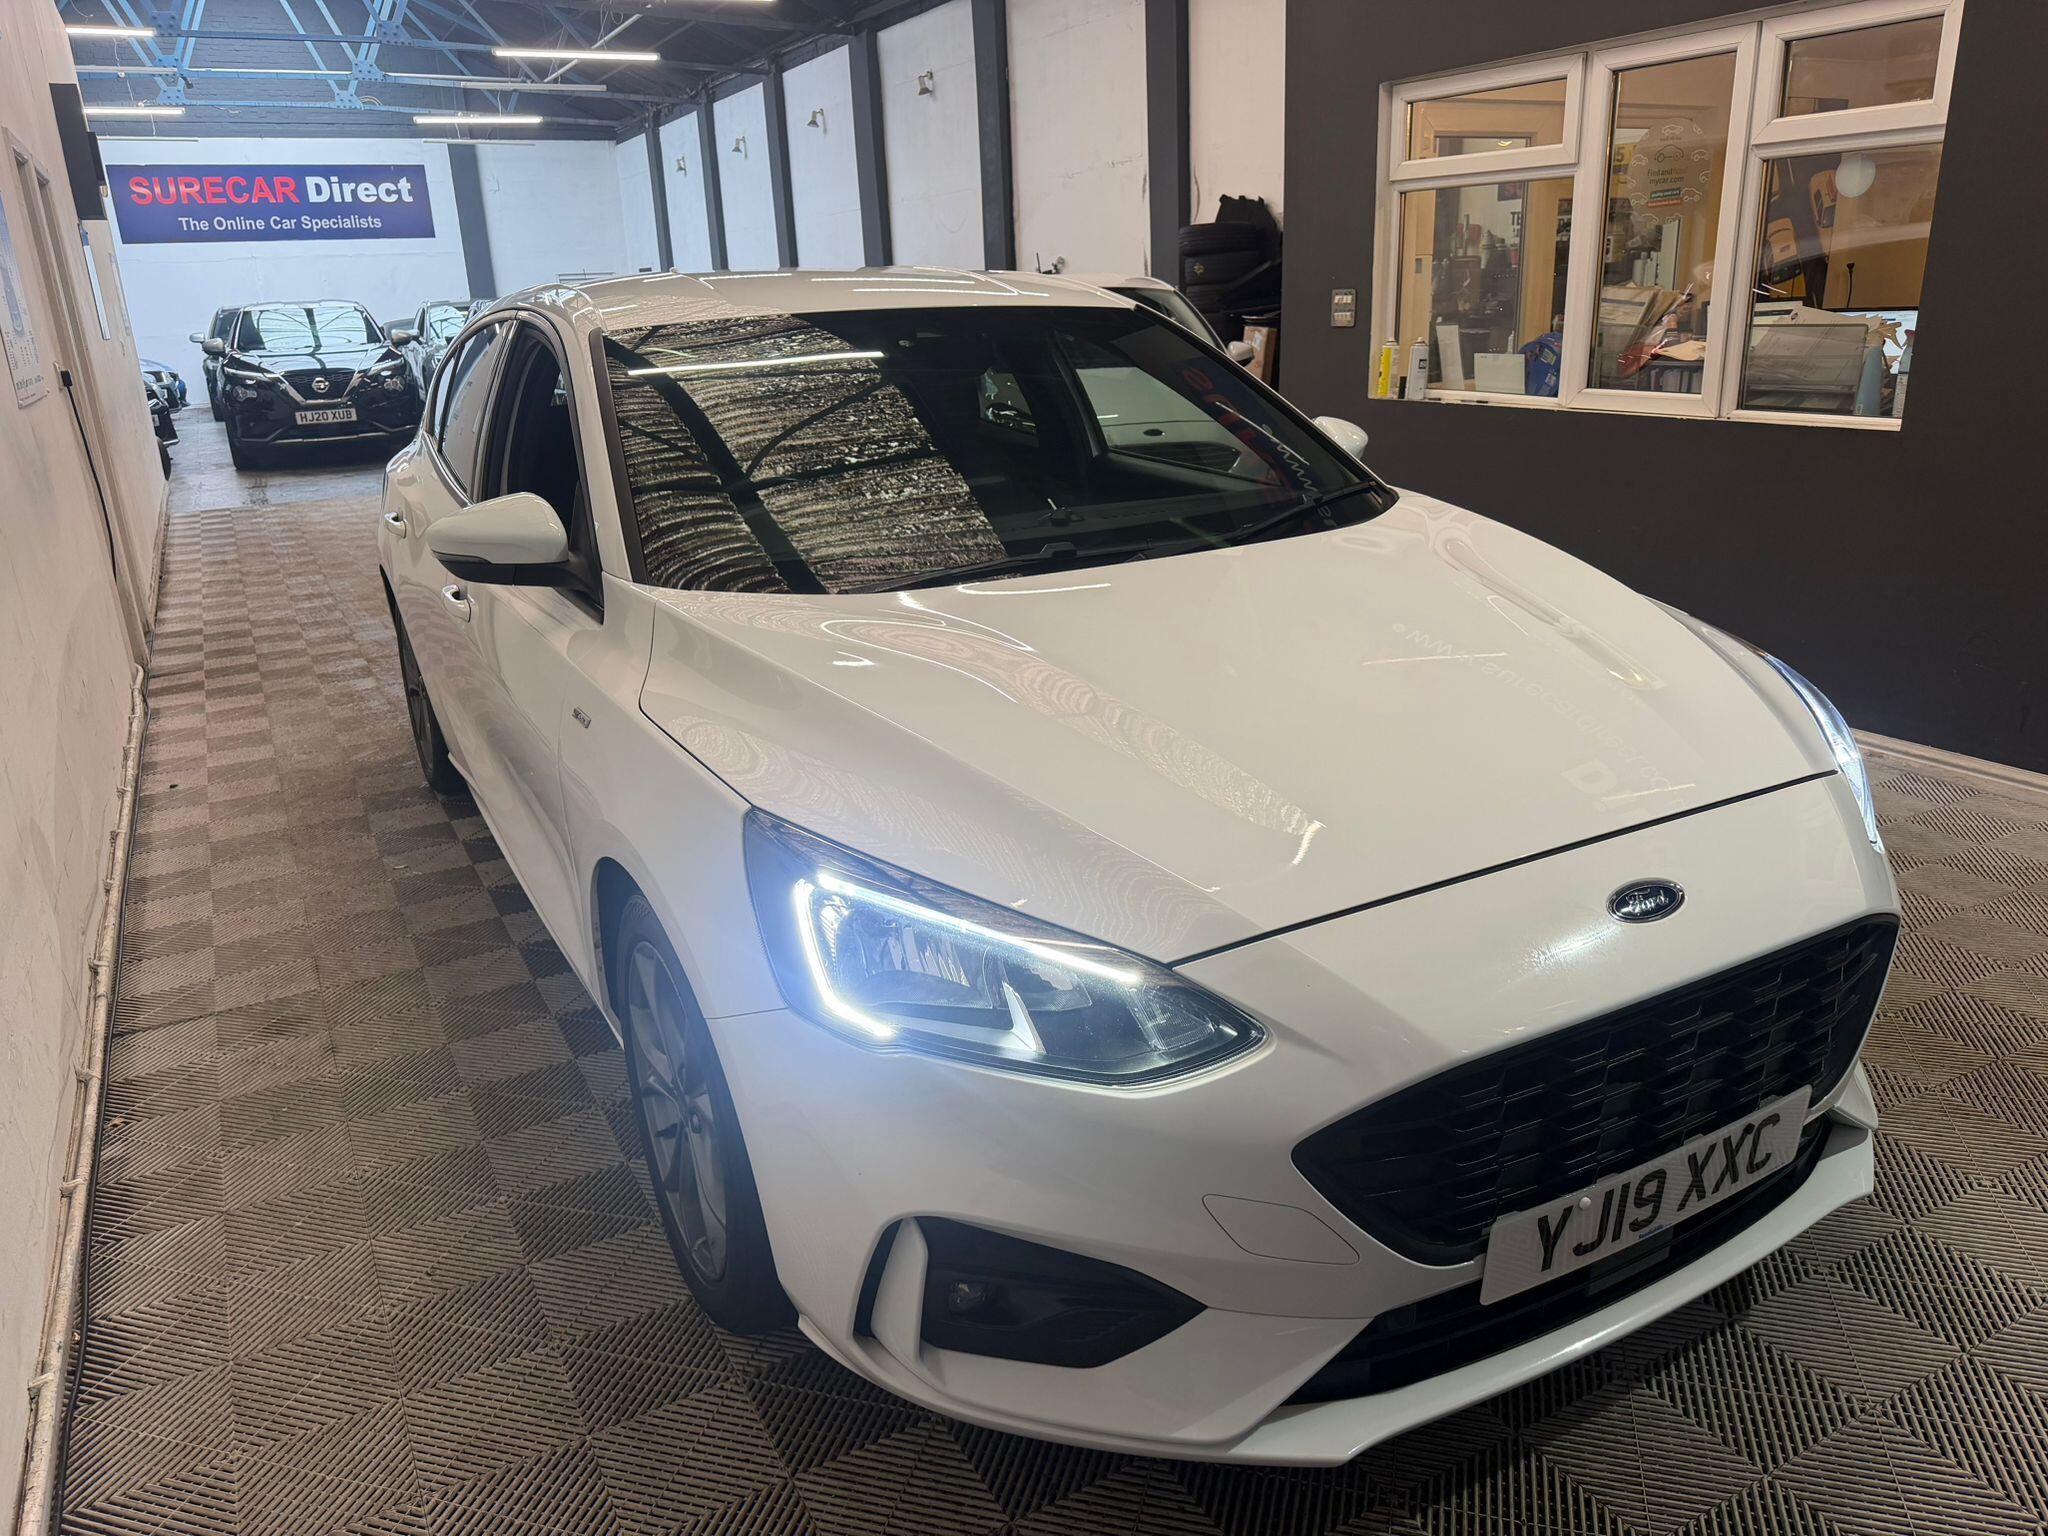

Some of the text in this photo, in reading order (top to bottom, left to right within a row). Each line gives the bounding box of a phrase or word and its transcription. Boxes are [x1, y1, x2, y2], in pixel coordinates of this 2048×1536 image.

[129, 175, 414, 205] SURECAR Direct
[178, 214, 382, 232] The Online Car Specialists
[300, 409, 353, 422] HJ20 XUB
[1620, 888, 1669, 915] Ford
[1537, 1112, 1781, 1272] YJ19 XXC
